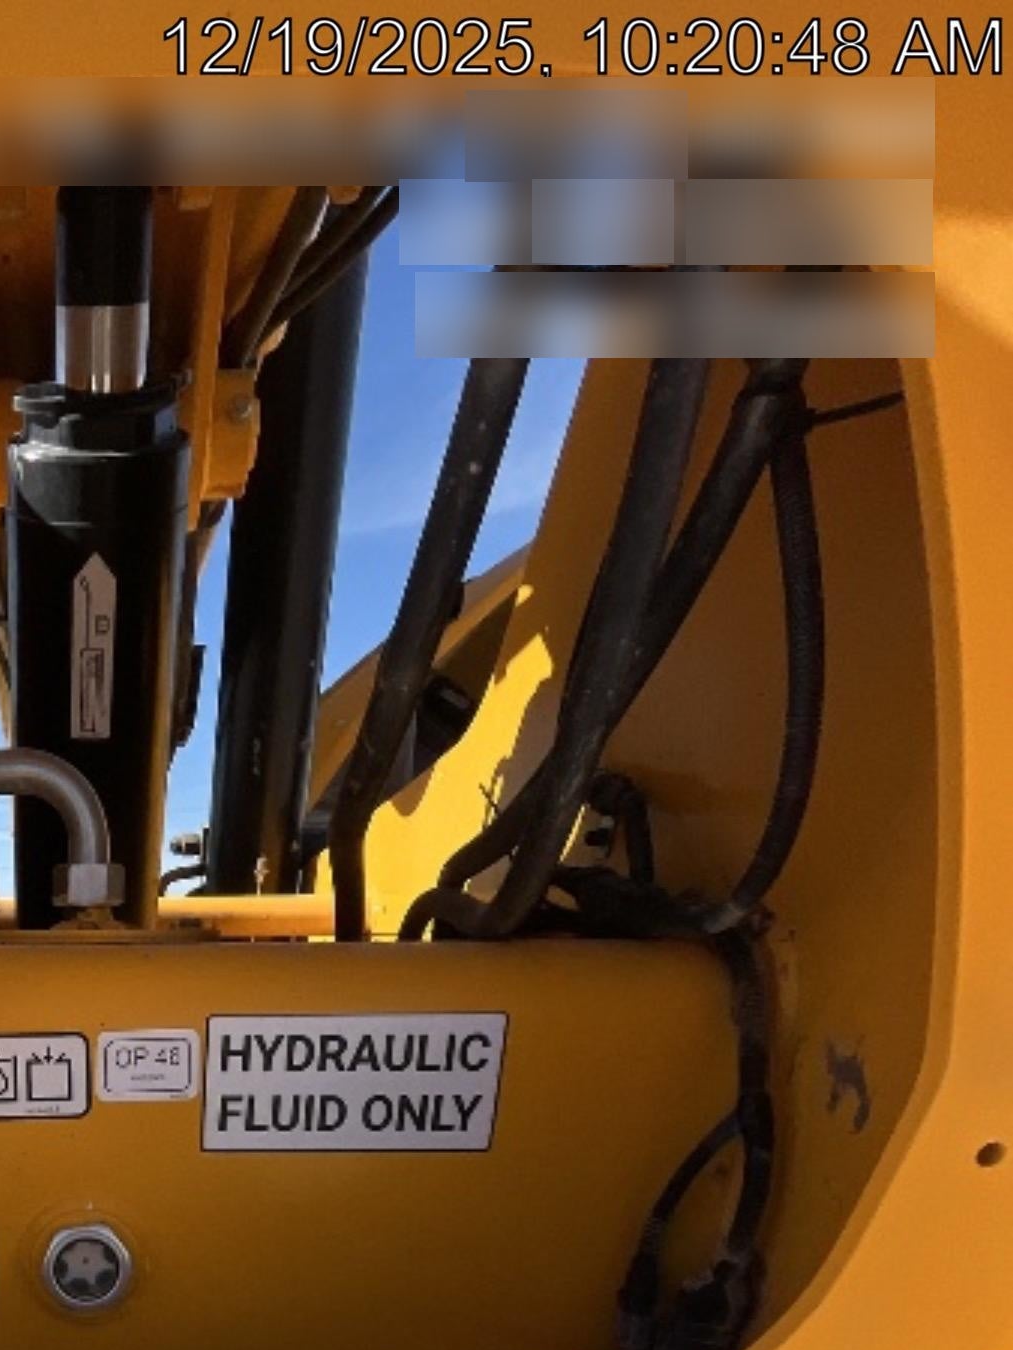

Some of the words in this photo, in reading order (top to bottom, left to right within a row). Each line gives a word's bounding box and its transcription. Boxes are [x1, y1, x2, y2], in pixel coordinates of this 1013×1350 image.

[220, 1033, 492, 1072] HYDRAULIC
[217, 1094, 348, 1132] FLUID
[361, 1094, 484, 1132] ONLY
